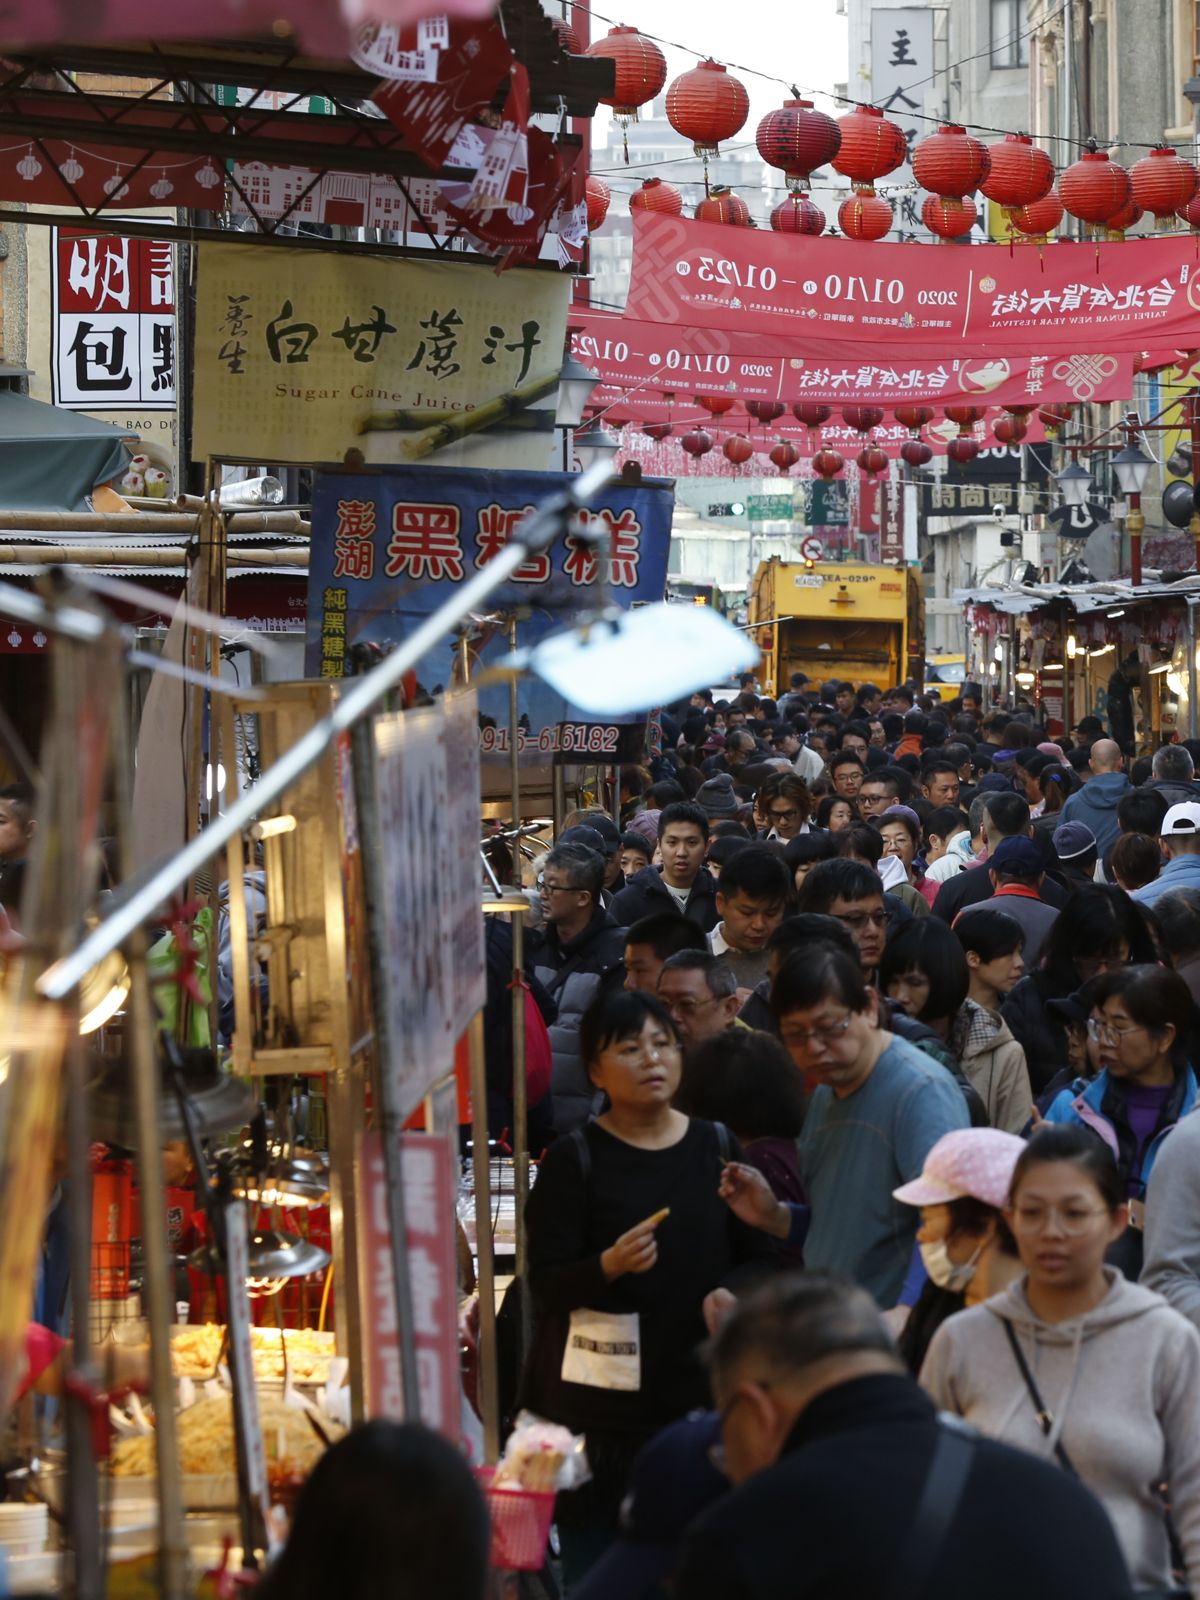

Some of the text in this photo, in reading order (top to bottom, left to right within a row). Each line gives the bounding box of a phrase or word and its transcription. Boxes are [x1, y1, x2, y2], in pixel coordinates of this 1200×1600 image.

[218, 295, 253, 374] 養生
[126, 420, 152, 429] BAO
[275, 383, 476, 413] Sugar Cane Juice
[333, 499, 376, 580] 澎湖
[321, 587, 348, 679] 純黑糖製
